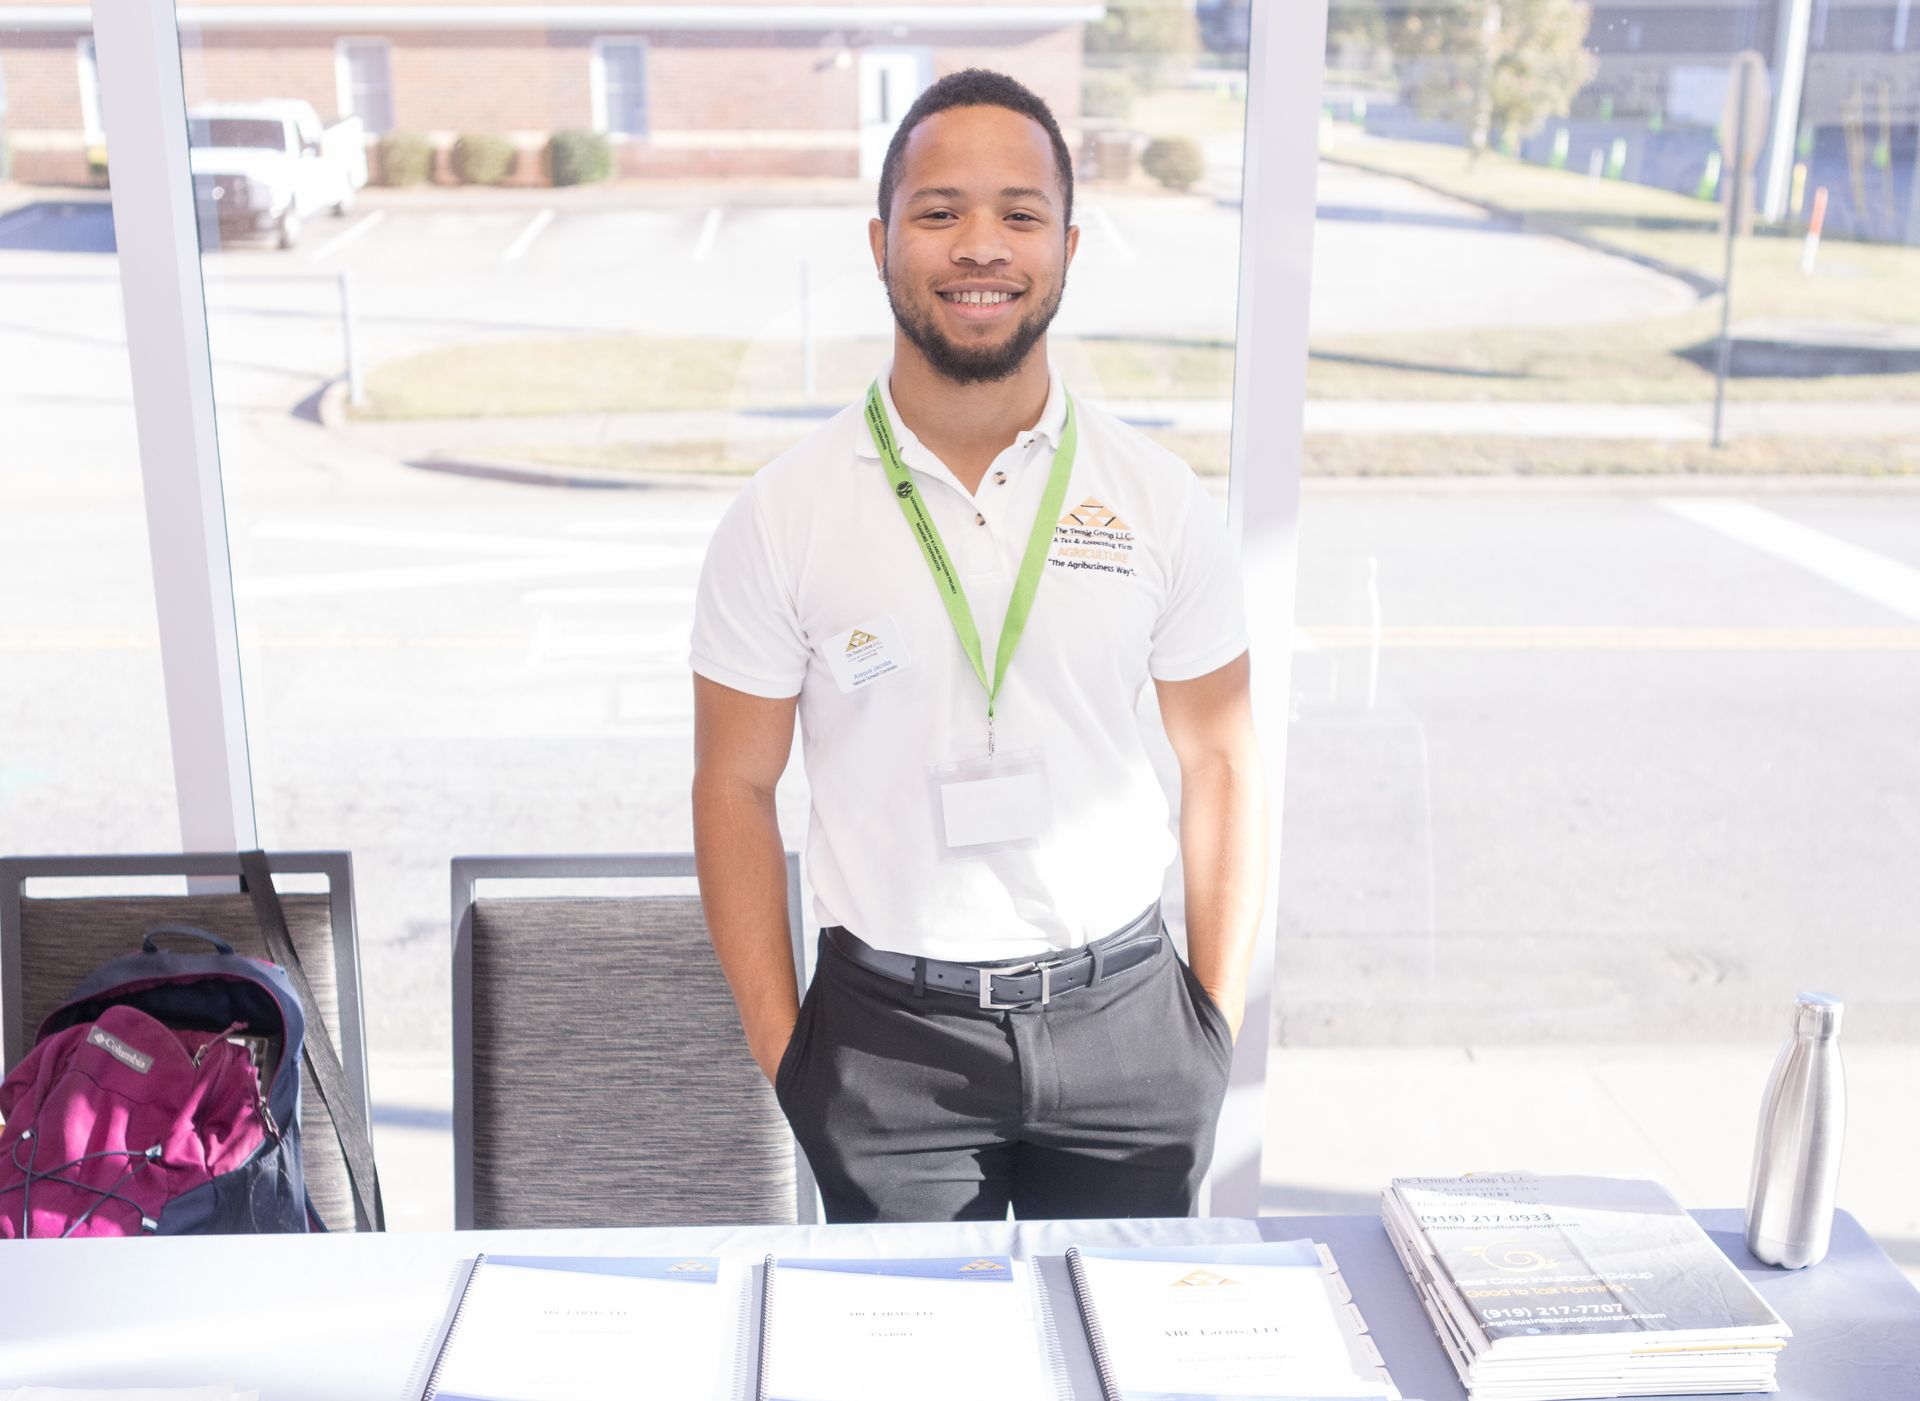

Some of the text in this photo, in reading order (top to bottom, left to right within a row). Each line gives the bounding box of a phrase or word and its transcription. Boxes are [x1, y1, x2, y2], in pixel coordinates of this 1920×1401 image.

[1055, 526, 1068, 534] The
[1093, 529, 1114, 540] Group
[1118, 543, 1133, 551] Firm
[1058, 547, 1129, 563] AGRICULTURE
[1067, 560, 1115, 573] Agribusiness
[105, 1037, 146, 1069] Columbia
[1459, 1175, 1498, 1185] Group
[1420, 1214, 1465, 1223] (919)
[1488, 1277, 1528, 1287] Crop
[1530, 1274, 1602, 1284] Insurance
[1605, 1271, 1654, 1281] Group
[1465, 1288, 1511, 1299] Good
[1513, 1288, 1530, 1296] to
[1532, 1286, 1561, 1296] Talk
[1482, 1303, 1623, 1321] (919) 217-7707
